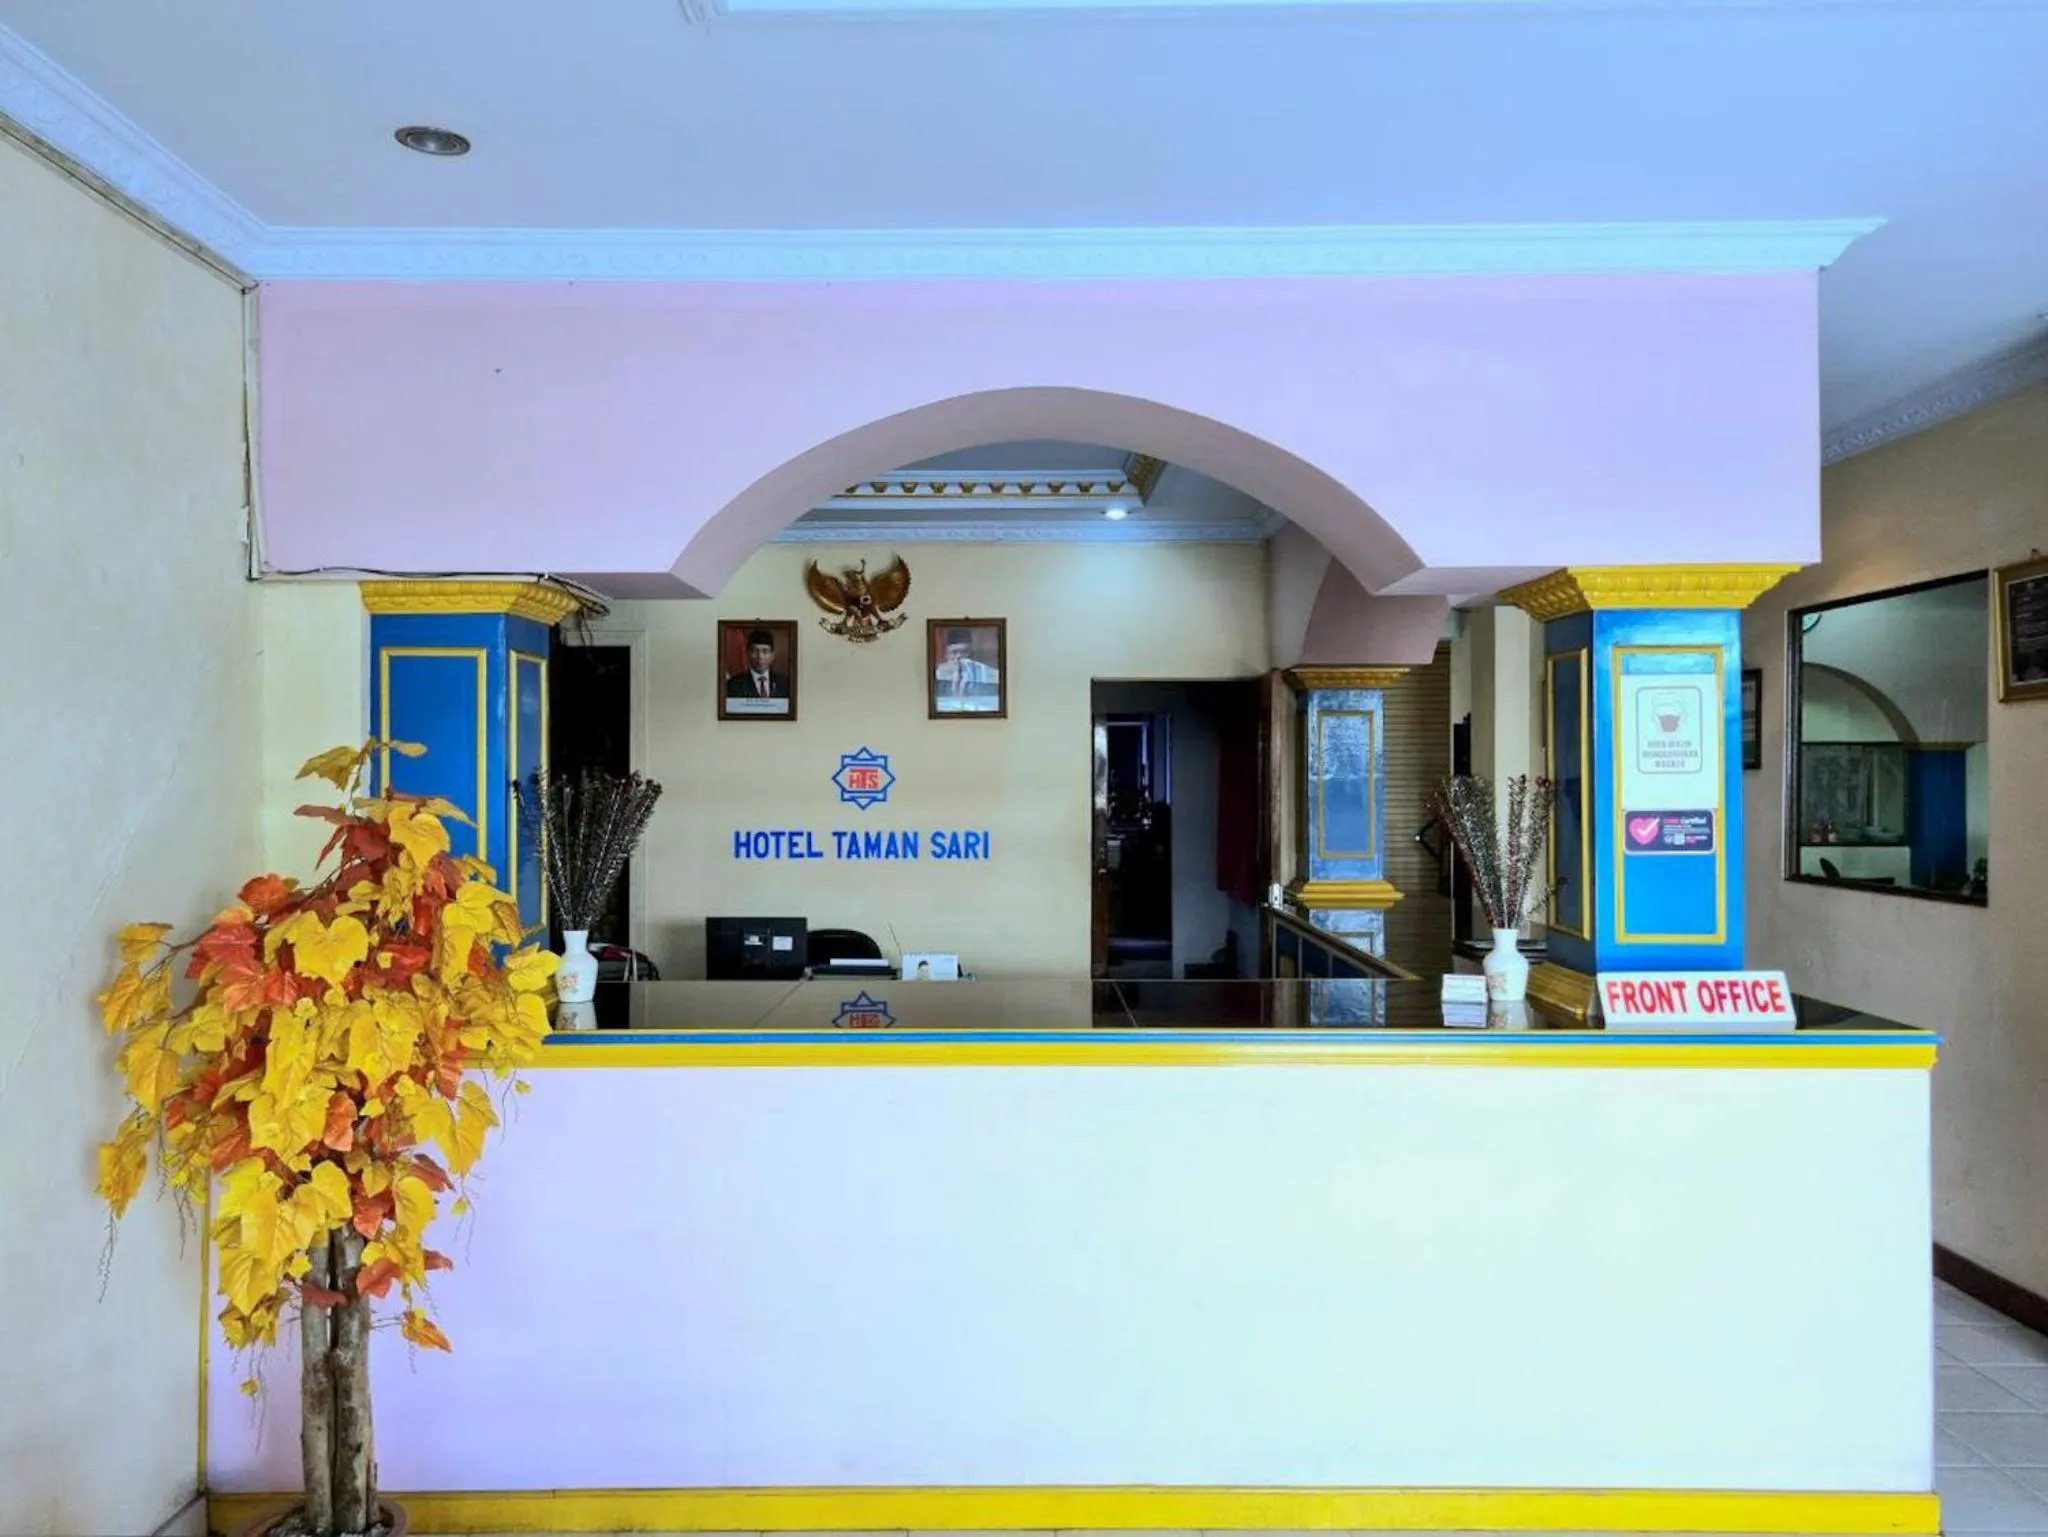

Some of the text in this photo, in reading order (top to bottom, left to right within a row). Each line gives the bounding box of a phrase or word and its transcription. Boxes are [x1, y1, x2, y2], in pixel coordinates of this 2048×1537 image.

[732, 829, 991, 861] HOTEL TAMAN SARI
[1605, 979, 1786, 1015] FRONT OFFICE
